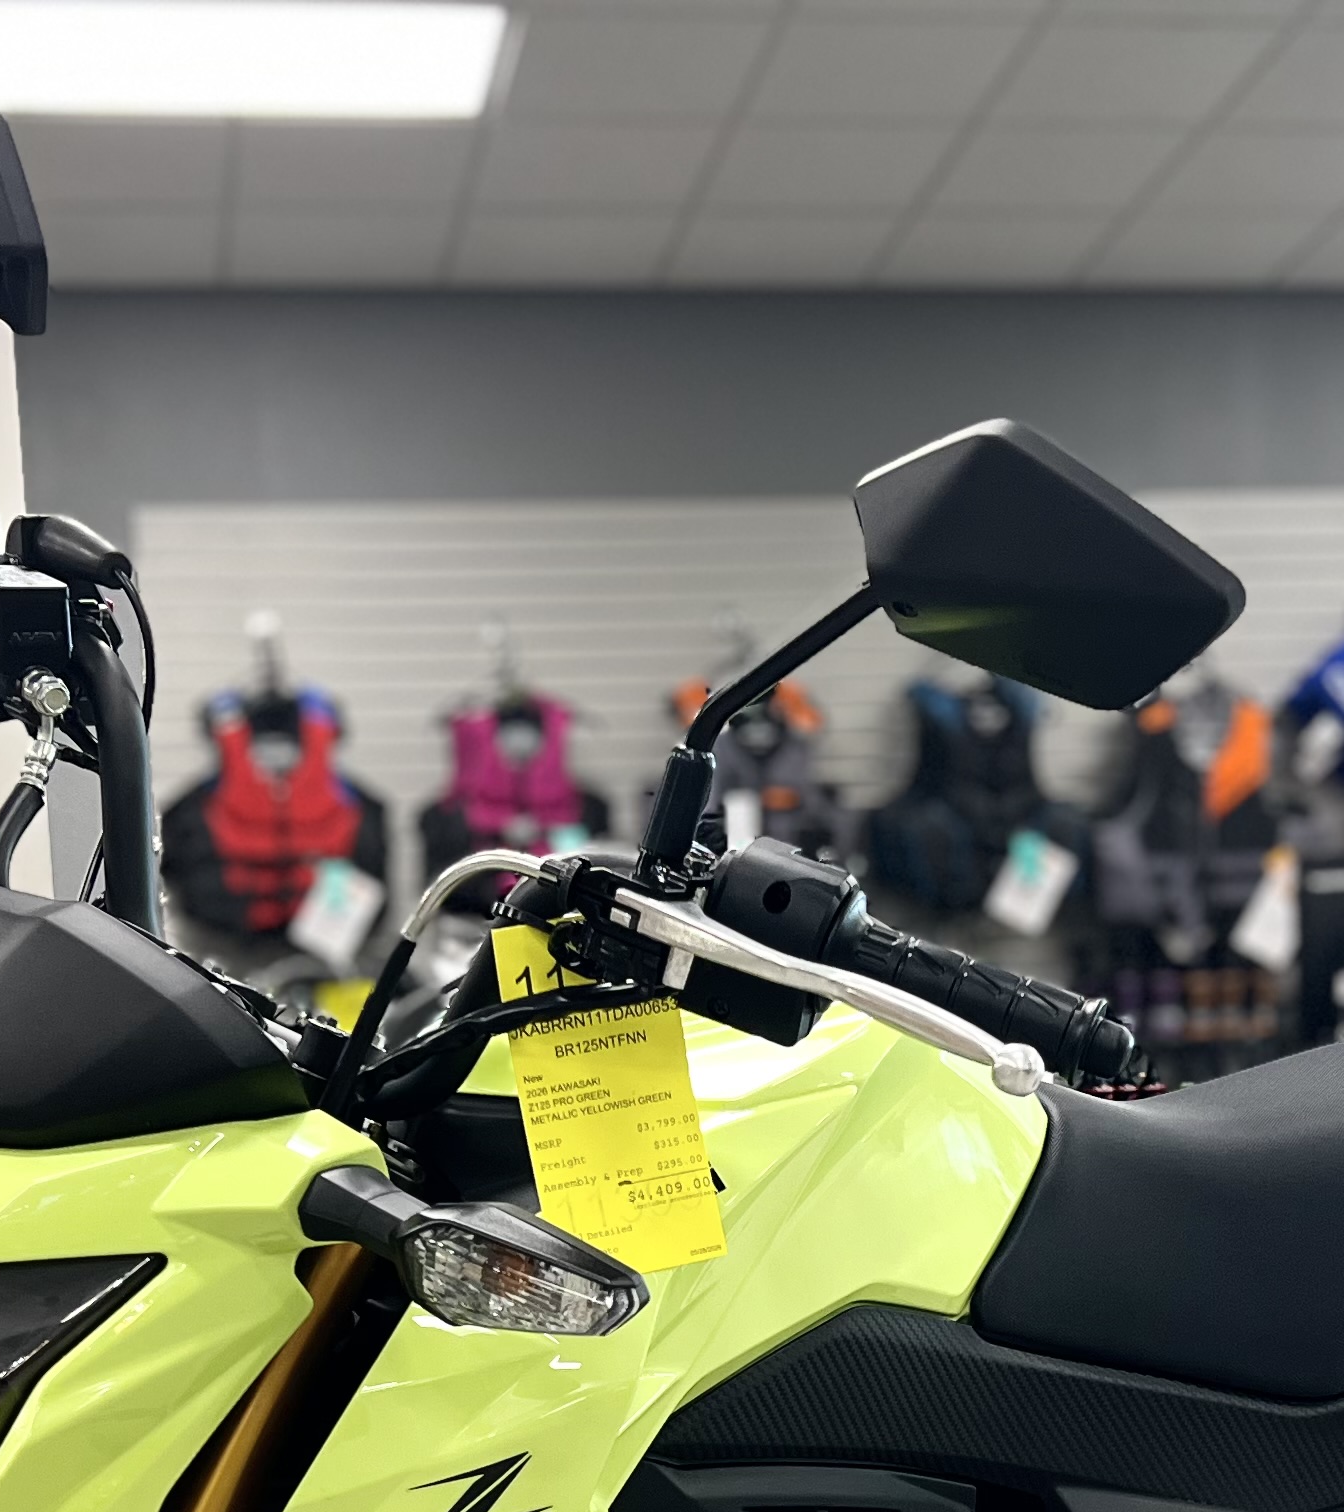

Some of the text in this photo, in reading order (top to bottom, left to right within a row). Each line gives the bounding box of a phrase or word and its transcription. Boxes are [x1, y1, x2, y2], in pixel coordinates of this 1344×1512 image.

[554, 1029, 647, 1059] BR125NTFNN
[523, 1074, 544, 1085] New
[550, 1077, 601, 1094] KAWASAKI
[530, 1091, 672, 1126] METALLIC YELLOWISH GREEN
[552, 1096, 575, 1109] PRO
[576, 1089, 611, 1104] GREEN
[534, 1113, 696, 1152] MSRP $3,799.00
[540, 1133, 700, 1173] Freight $315.00
[543, 1174, 597, 1194] Assembly
[616, 1167, 644, 1180] Prep
[656, 1154, 703, 1171] $295.00
[627, 1176, 711, 1204] $4,409.00
[586, 1224, 633, 1241] Detailed
